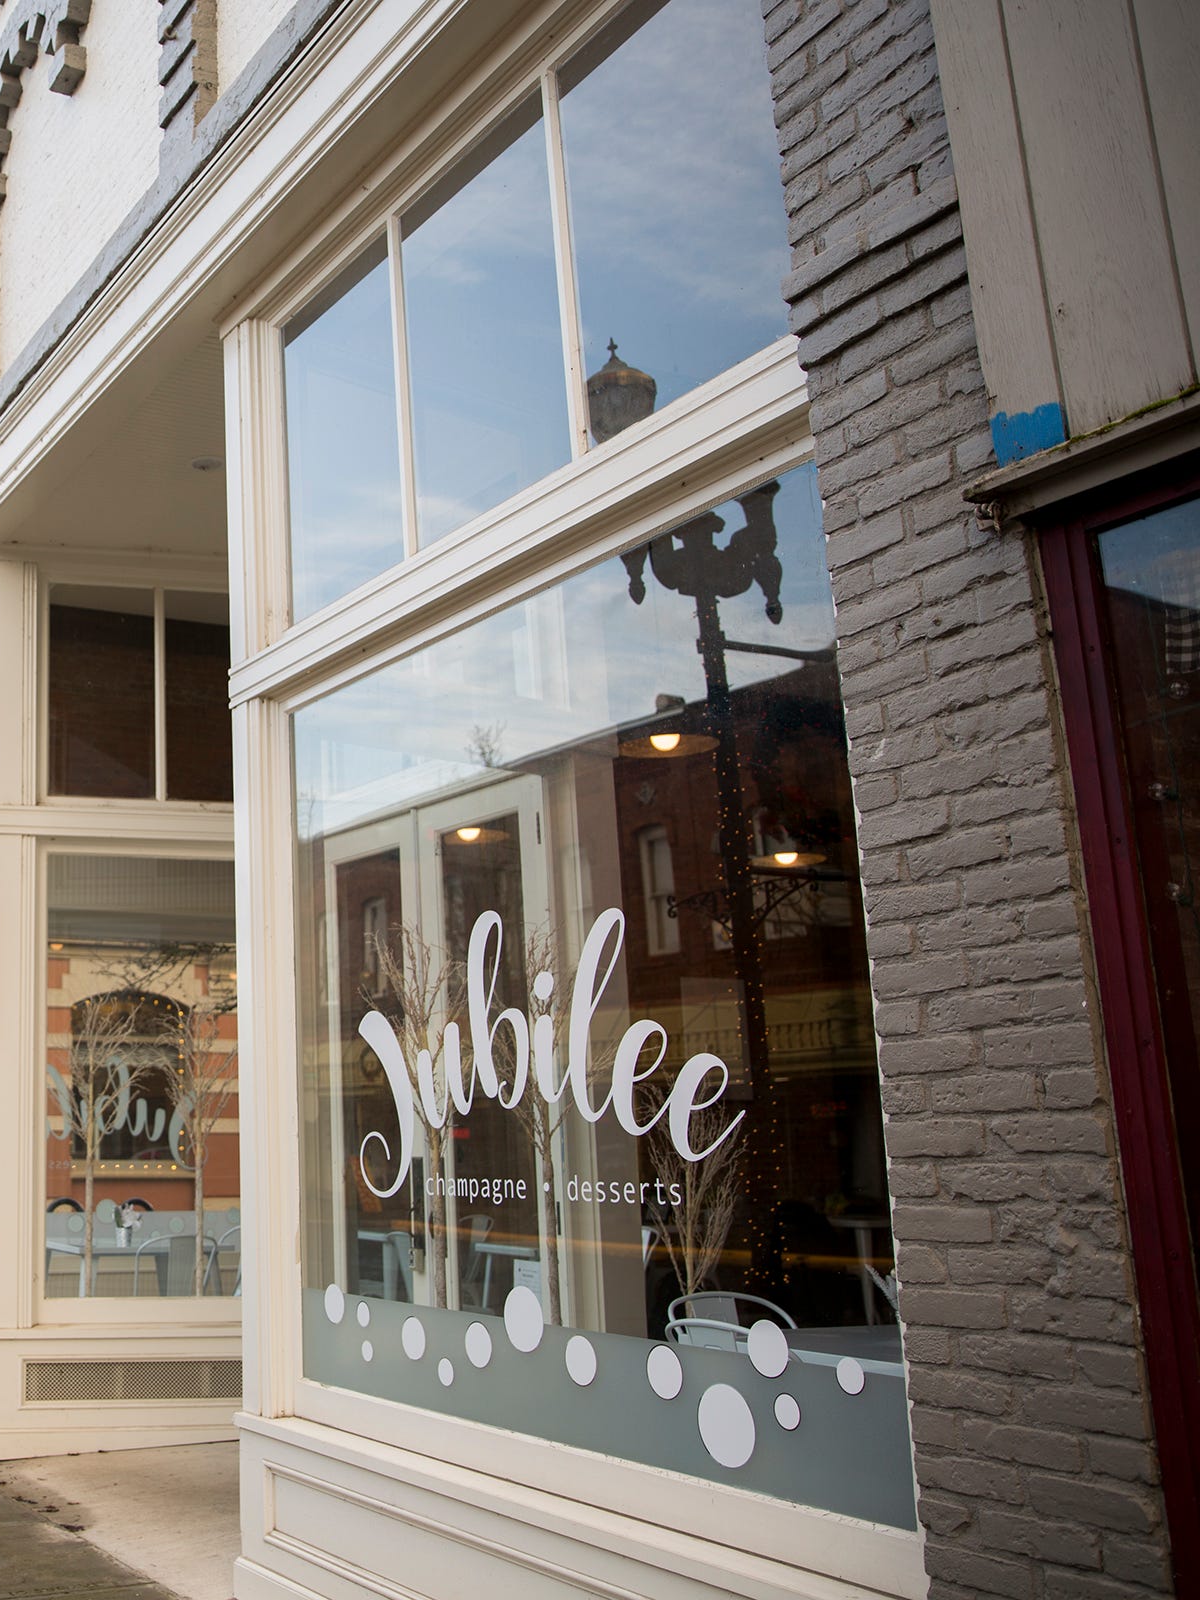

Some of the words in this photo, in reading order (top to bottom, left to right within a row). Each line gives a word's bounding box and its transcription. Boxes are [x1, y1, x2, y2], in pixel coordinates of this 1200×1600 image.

[358, 907, 746, 1198] Jubilee
[425, 1172, 527, 1205] champagne
[567, 1175, 682, 1206] desserts
